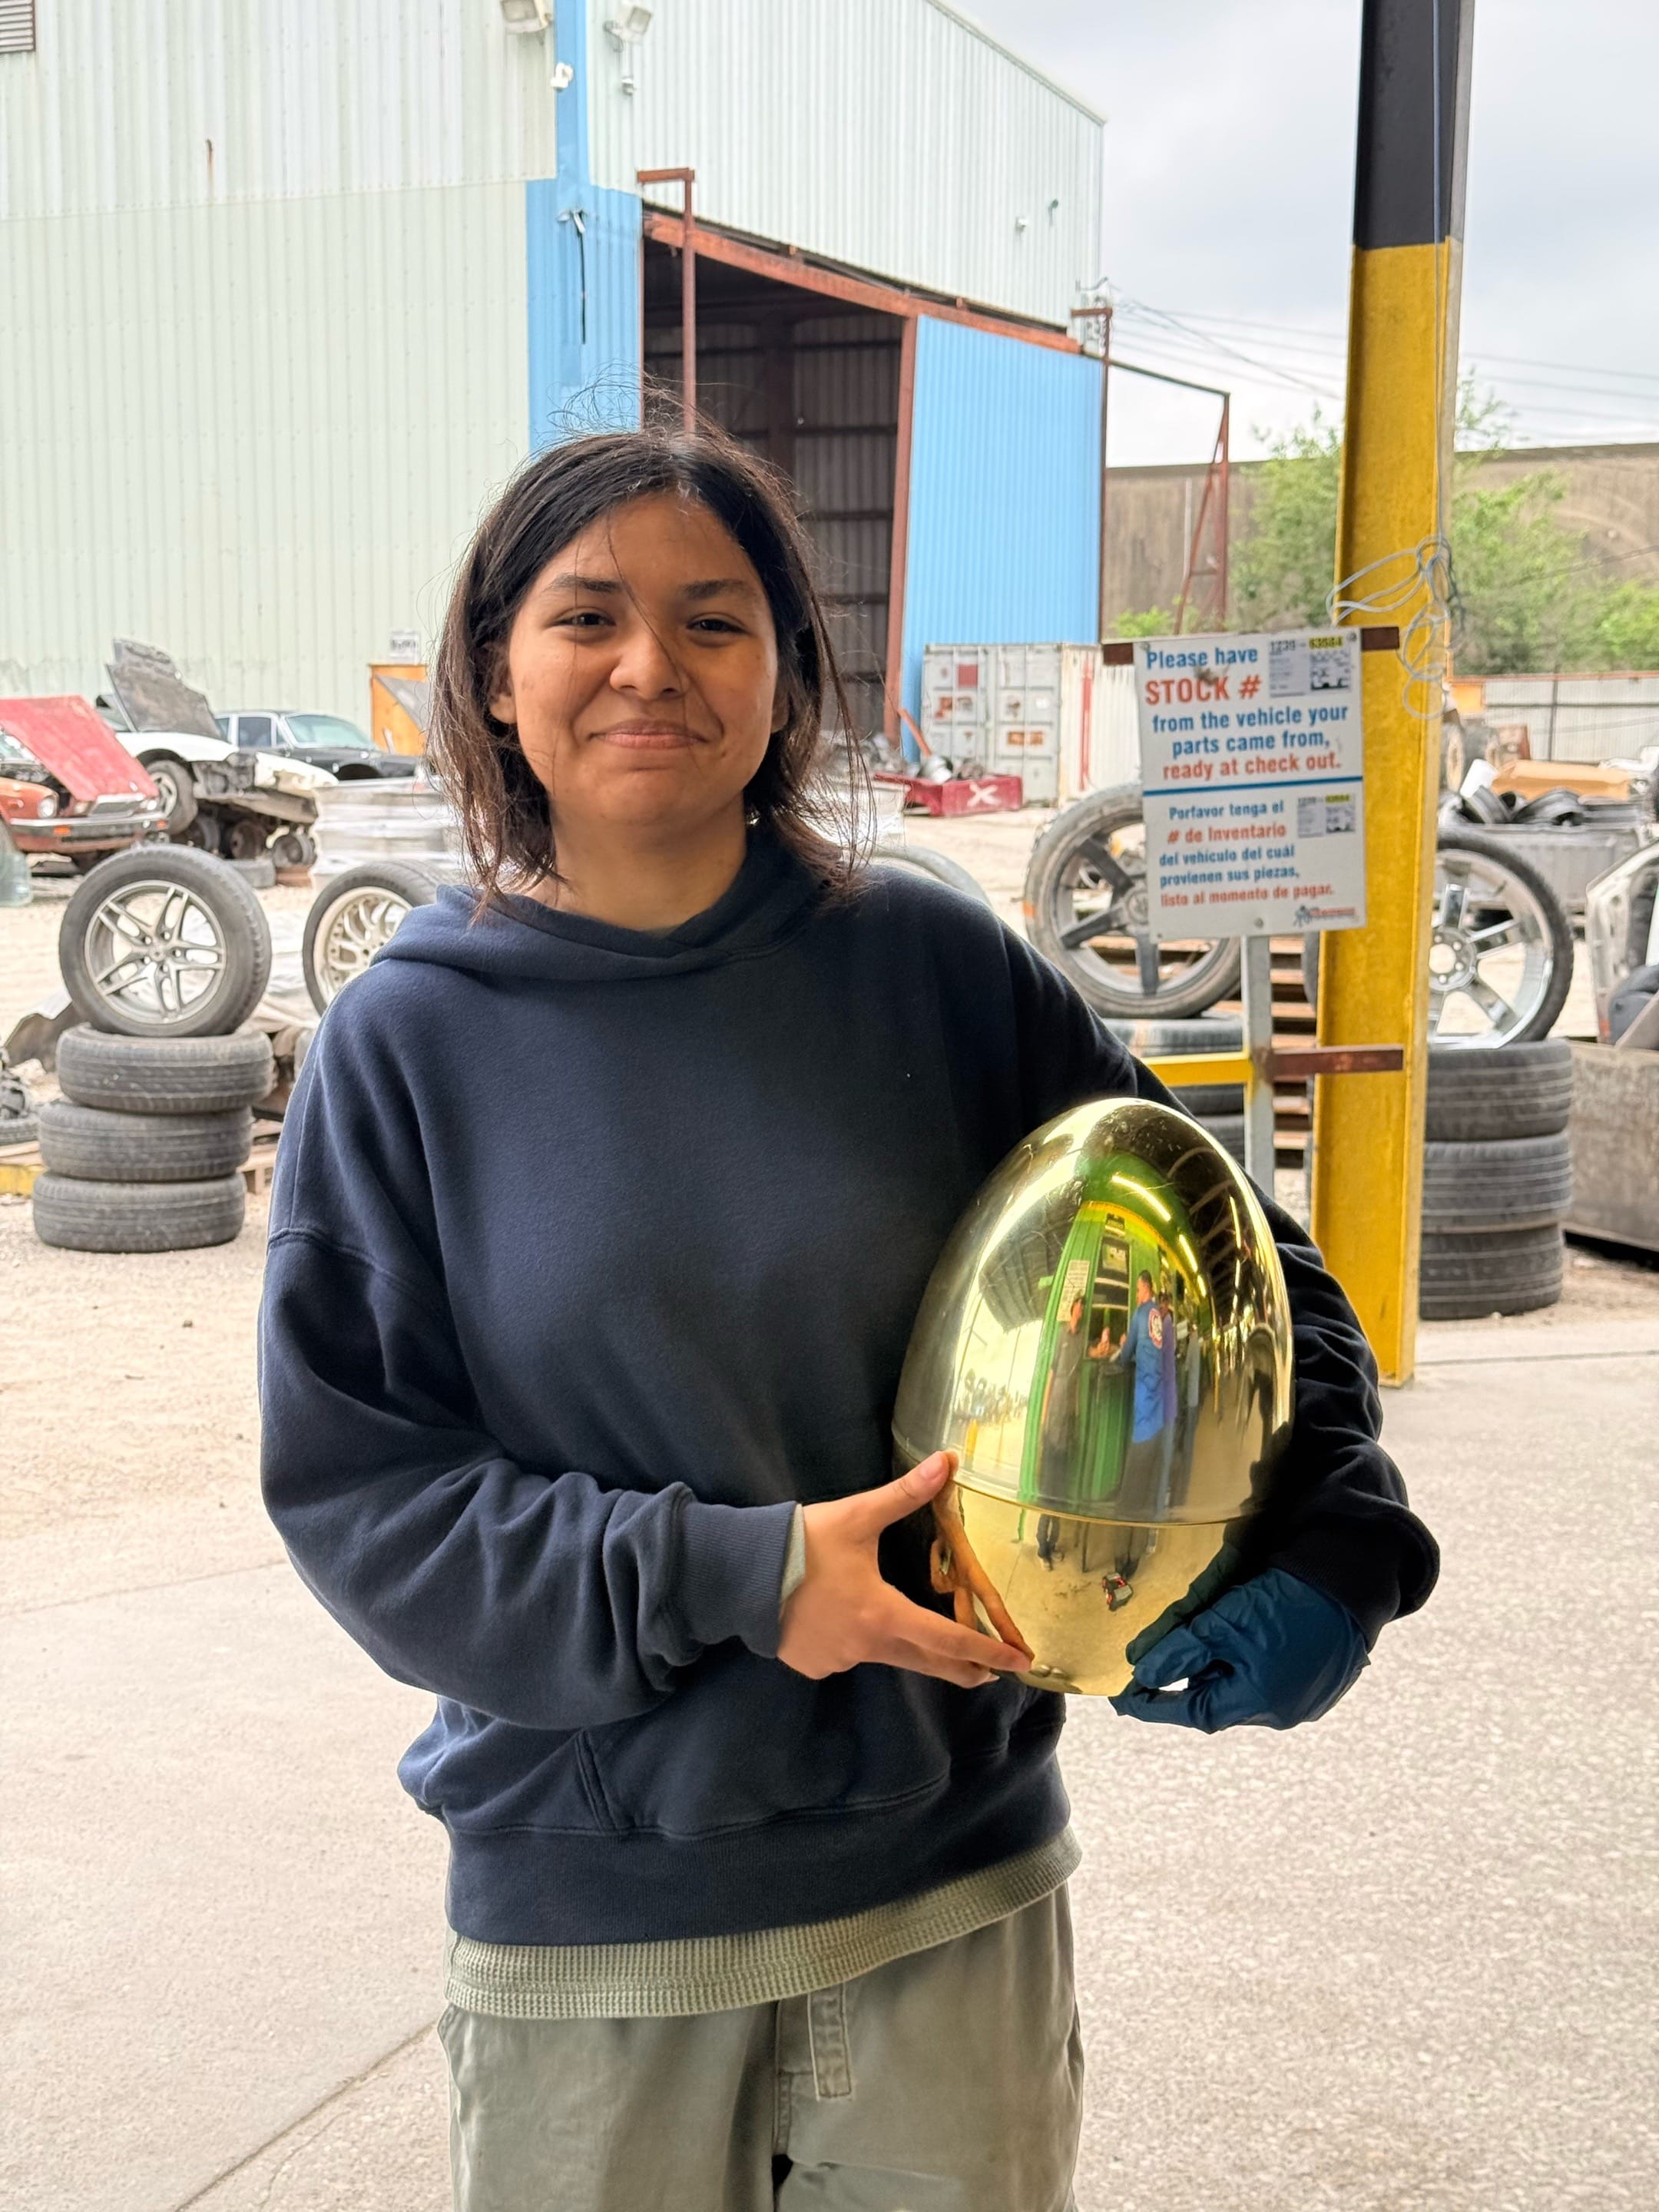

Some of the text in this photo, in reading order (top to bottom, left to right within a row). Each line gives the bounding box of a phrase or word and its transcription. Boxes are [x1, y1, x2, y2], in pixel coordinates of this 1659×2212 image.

[1147, 647, 1258, 670] Please have
[1145, 675, 1230, 706] STOCK
[1237, 674, 1263, 700] #
[1152, 705, 1349, 733] from the vehicle your
[1172, 729, 1330, 760] parts came from,
[1163, 751, 1341, 782] ready at check out.
[1169, 805, 1224, 821] Porfavor
[1229, 802, 1267, 819] tenga
[1272, 800, 1284, 814] el
[1185, 827, 1203, 843] de
[1208, 821, 1287, 842] Inventario
[1159, 852, 1179, 867] del
[1241, 846, 1262, 861] del
[1160, 871, 1223, 889] provienen
[1227, 869, 1250, 882] sus
[1161, 892, 1189, 908] listo
[1193, 890, 1205, 906] al
[1209, 886, 1268, 904] momento
[1273, 885, 1289, 899] de
